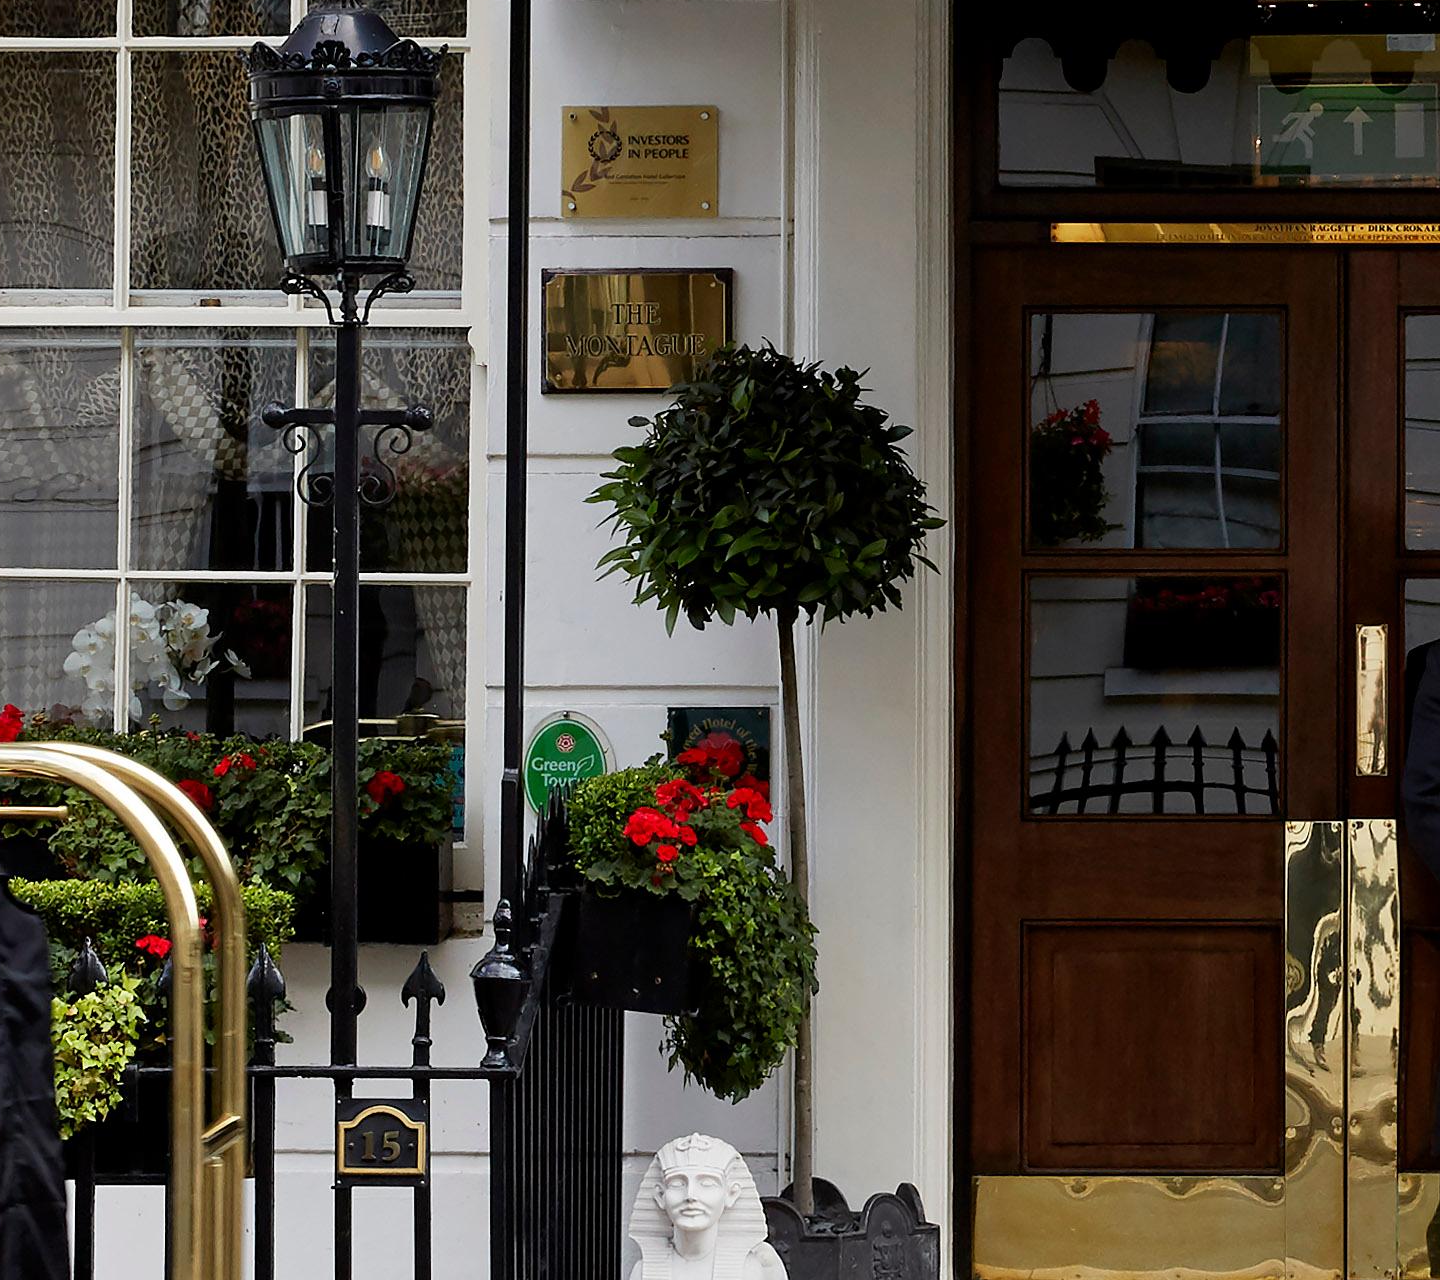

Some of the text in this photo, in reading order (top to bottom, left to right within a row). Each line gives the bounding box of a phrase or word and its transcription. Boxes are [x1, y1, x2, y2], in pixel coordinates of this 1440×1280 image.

[627, 135, 690, 146] INVESTORS
[627, 148, 690, 159] IN PEOPLE
[1255, 223, 1308, 233] JONATHAN
[1310, 223, 1357, 232] RAGGETT
[1368, 224, 1393, 232] DIRK
[610, 302, 662, 326] THE
[566, 332, 707, 358] MONTAGUE
[531, 756, 576, 772] Green
[361, 1129, 402, 1163] 15
